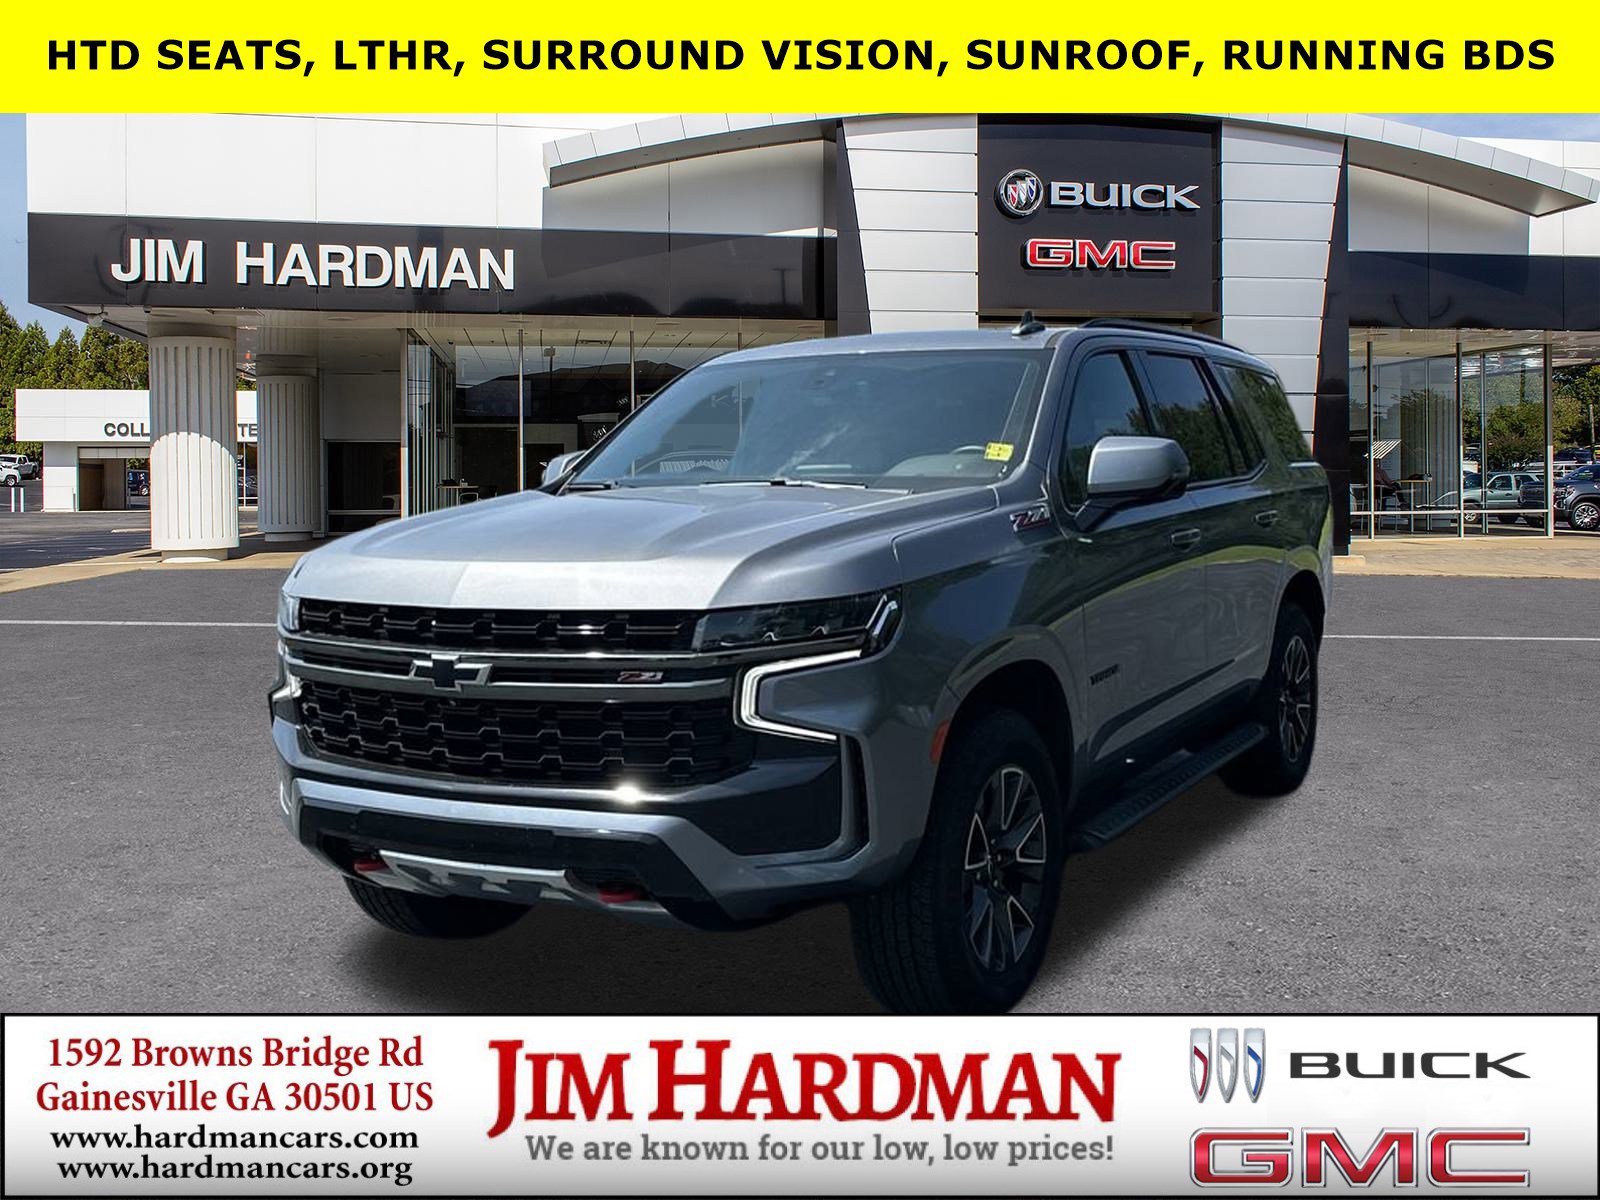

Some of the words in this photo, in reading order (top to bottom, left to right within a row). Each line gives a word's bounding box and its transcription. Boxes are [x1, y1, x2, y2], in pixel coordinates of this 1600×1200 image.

[1050, 181, 1200, 209] BUICK
[111, 238, 204, 284] JIM
[235, 241, 515, 290] HARDMAN
[1026, 238, 1176, 270] GMC
[104, 422, 150, 437] COLL
